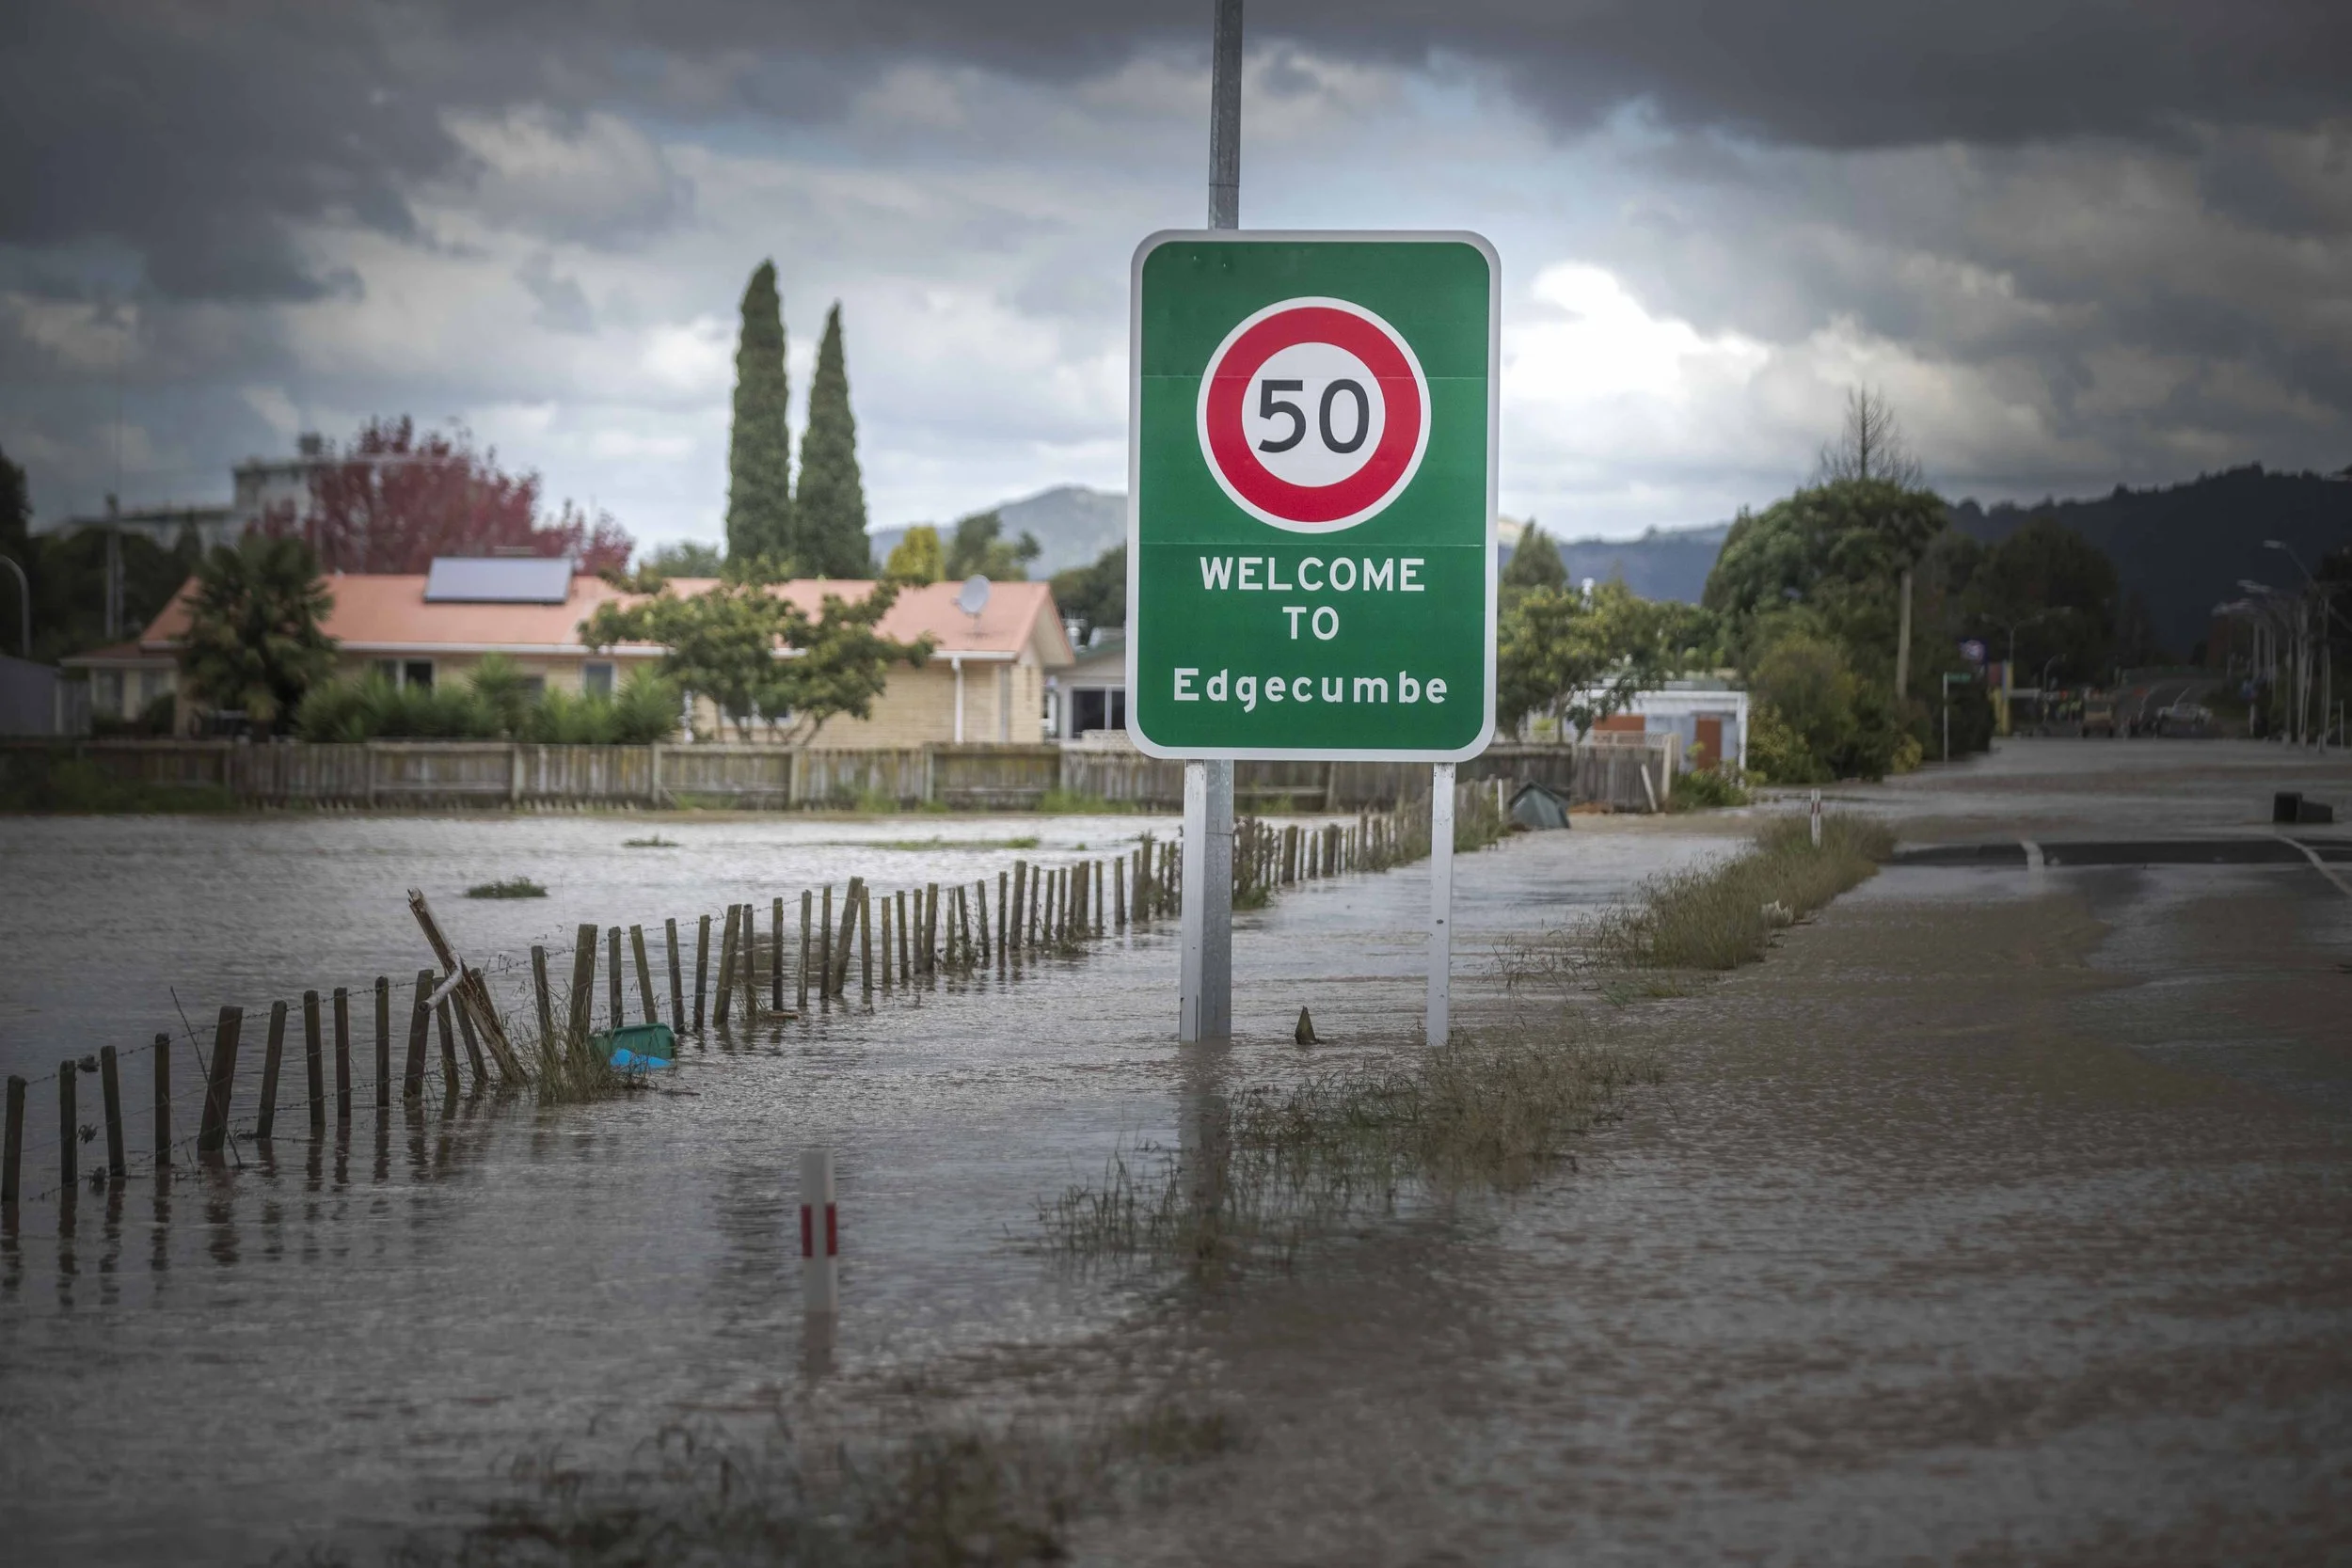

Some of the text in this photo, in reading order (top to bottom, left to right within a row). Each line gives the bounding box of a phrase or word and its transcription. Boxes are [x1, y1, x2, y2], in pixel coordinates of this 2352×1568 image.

[1258, 379, 1370, 454] 50
[1200, 556, 1425, 592] WELCOME
[1282, 606, 1340, 641] TO
[1173, 667, 1448, 713] Edgecumbe
